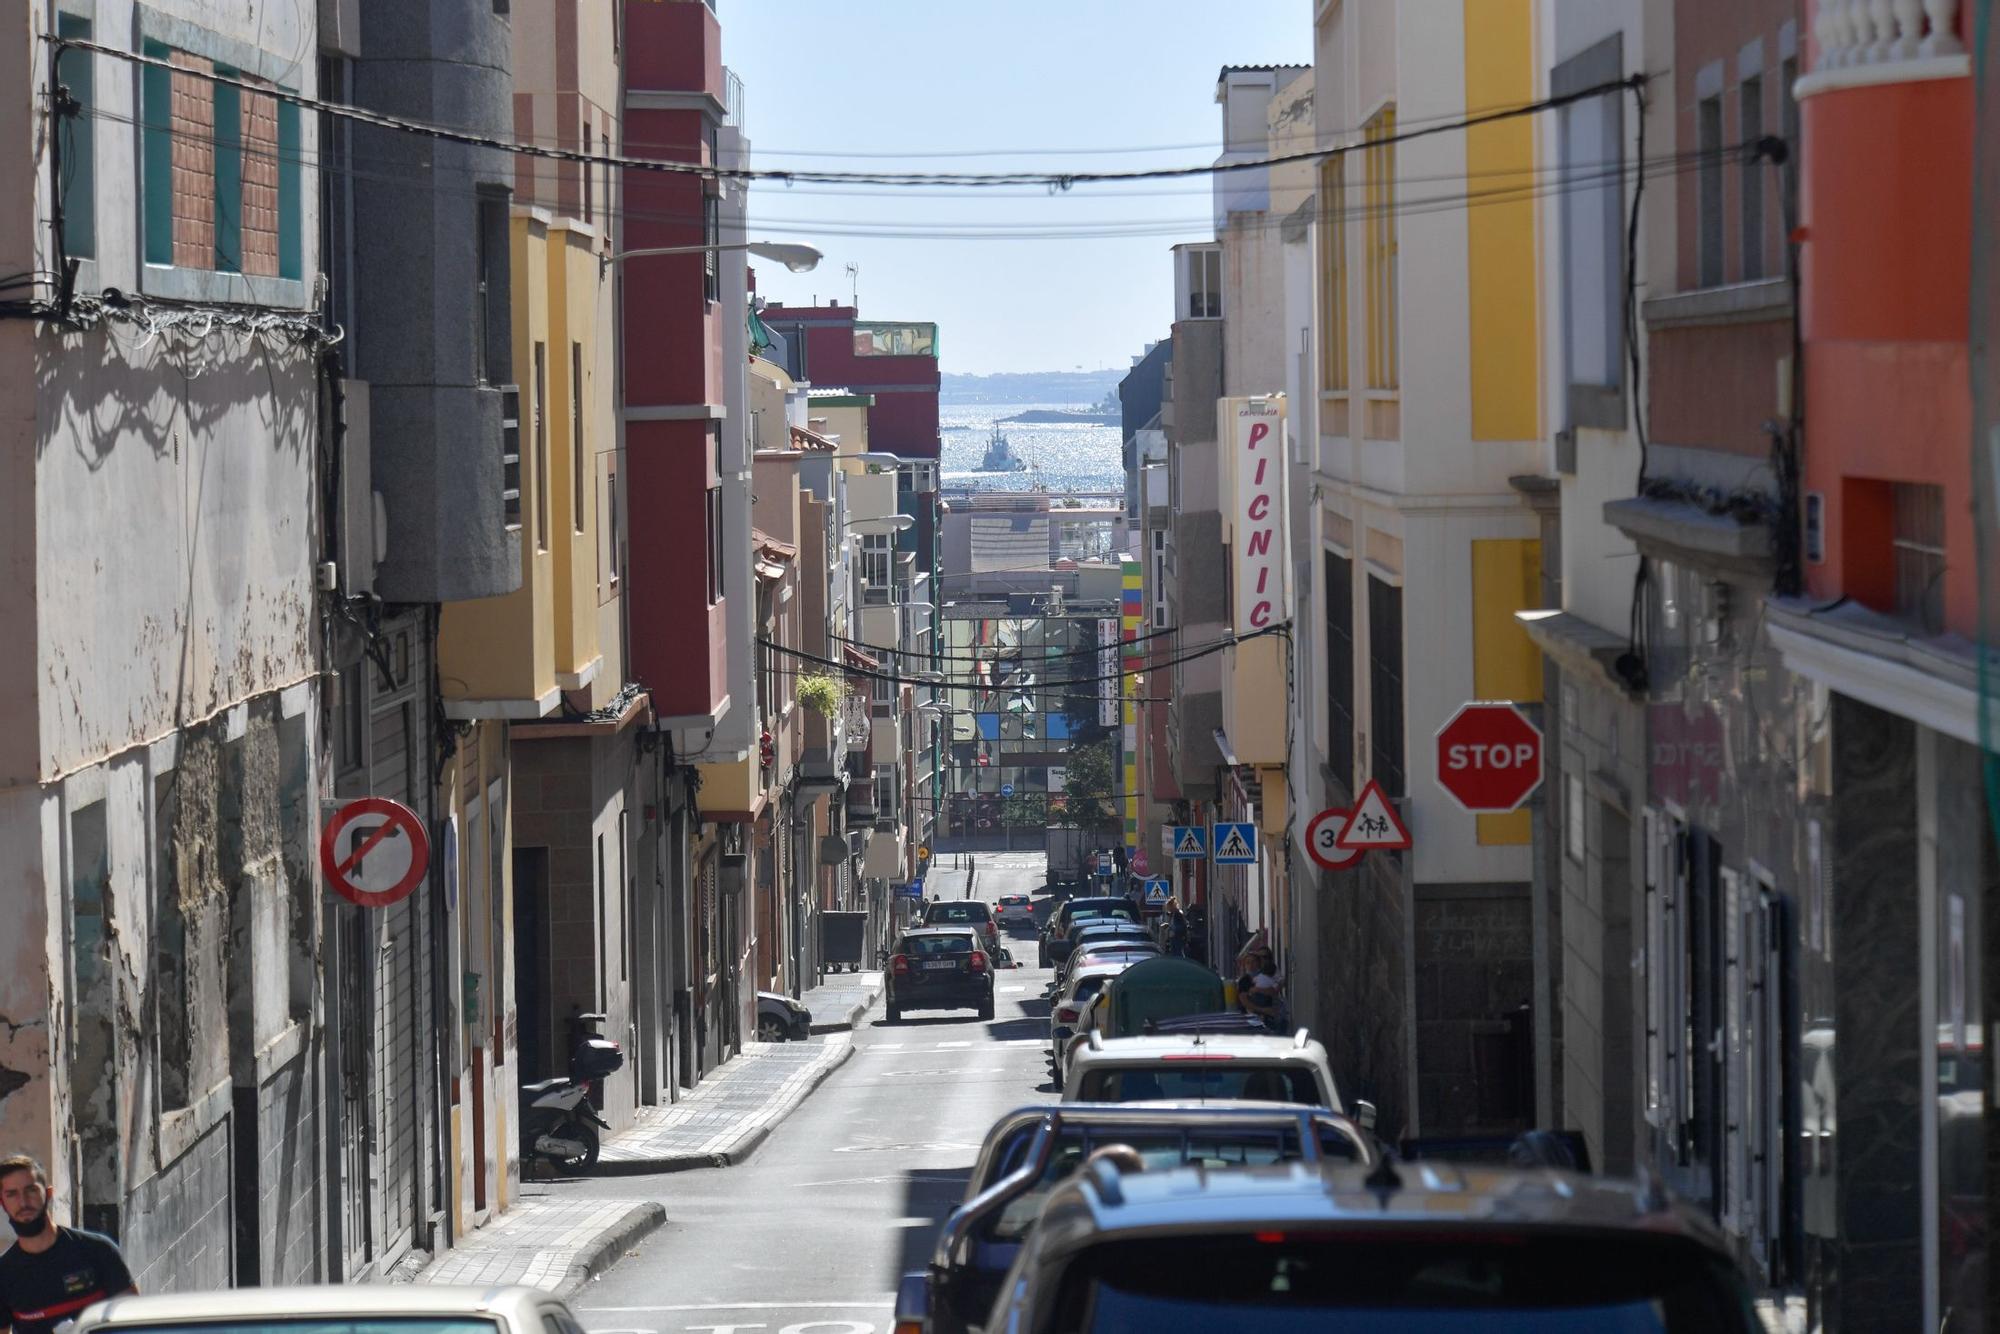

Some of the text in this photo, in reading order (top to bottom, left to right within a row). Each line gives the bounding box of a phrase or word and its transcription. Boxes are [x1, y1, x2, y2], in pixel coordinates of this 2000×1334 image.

[1248, 423, 1272, 627] PICNIC
[1448, 744, 1533, 769] STOP
[1321, 829, 1335, 848] 3
